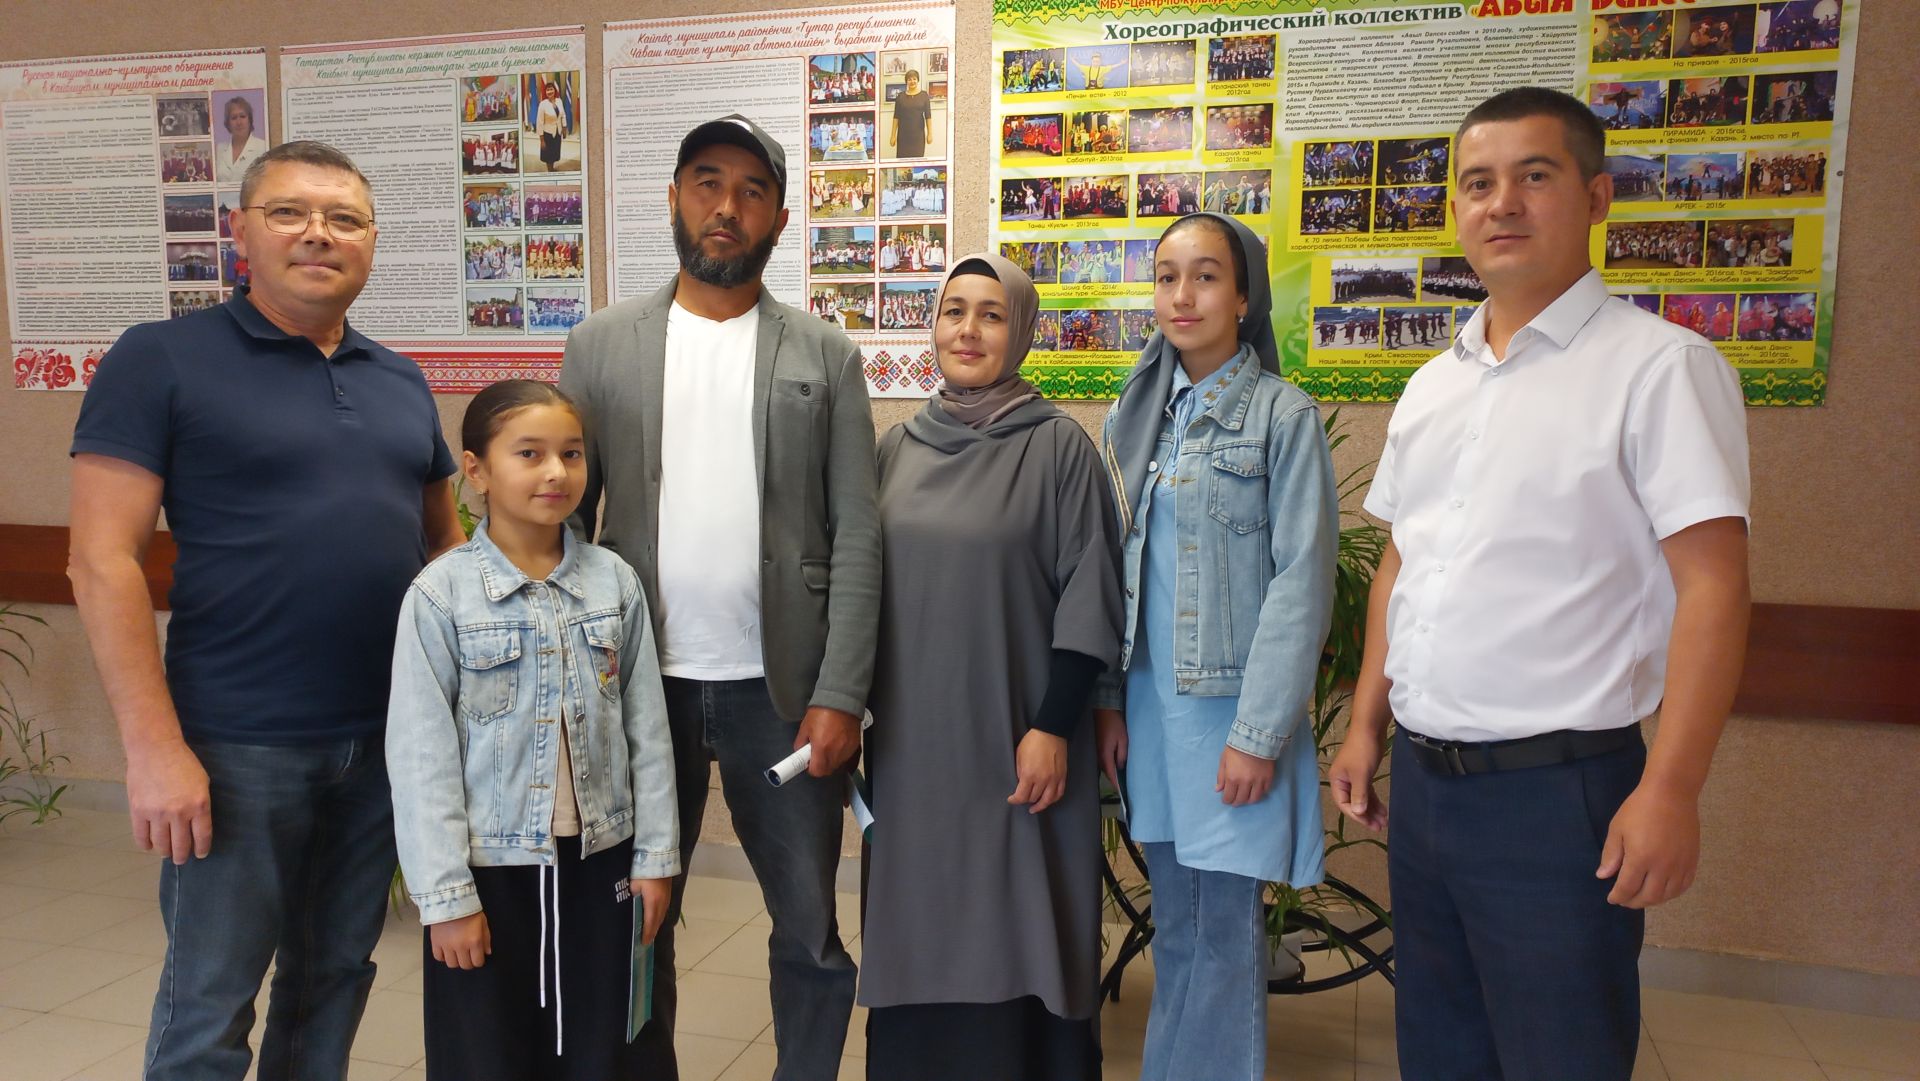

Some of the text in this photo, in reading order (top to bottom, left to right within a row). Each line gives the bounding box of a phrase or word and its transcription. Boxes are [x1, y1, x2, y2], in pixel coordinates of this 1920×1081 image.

[1104, 11, 1326, 41] Хореографический
[1334, 5, 1462, 26] коллектив
[702, 43, 750, 59] культура
[296, 56, 344, 67] Татарстан
[175, 59, 234, 78] объединение
[180, 77, 214, 89] районе
[1662, 128, 1705, 137] ПИРАМИДА
[1610, 137, 1656, 146] Выступление
